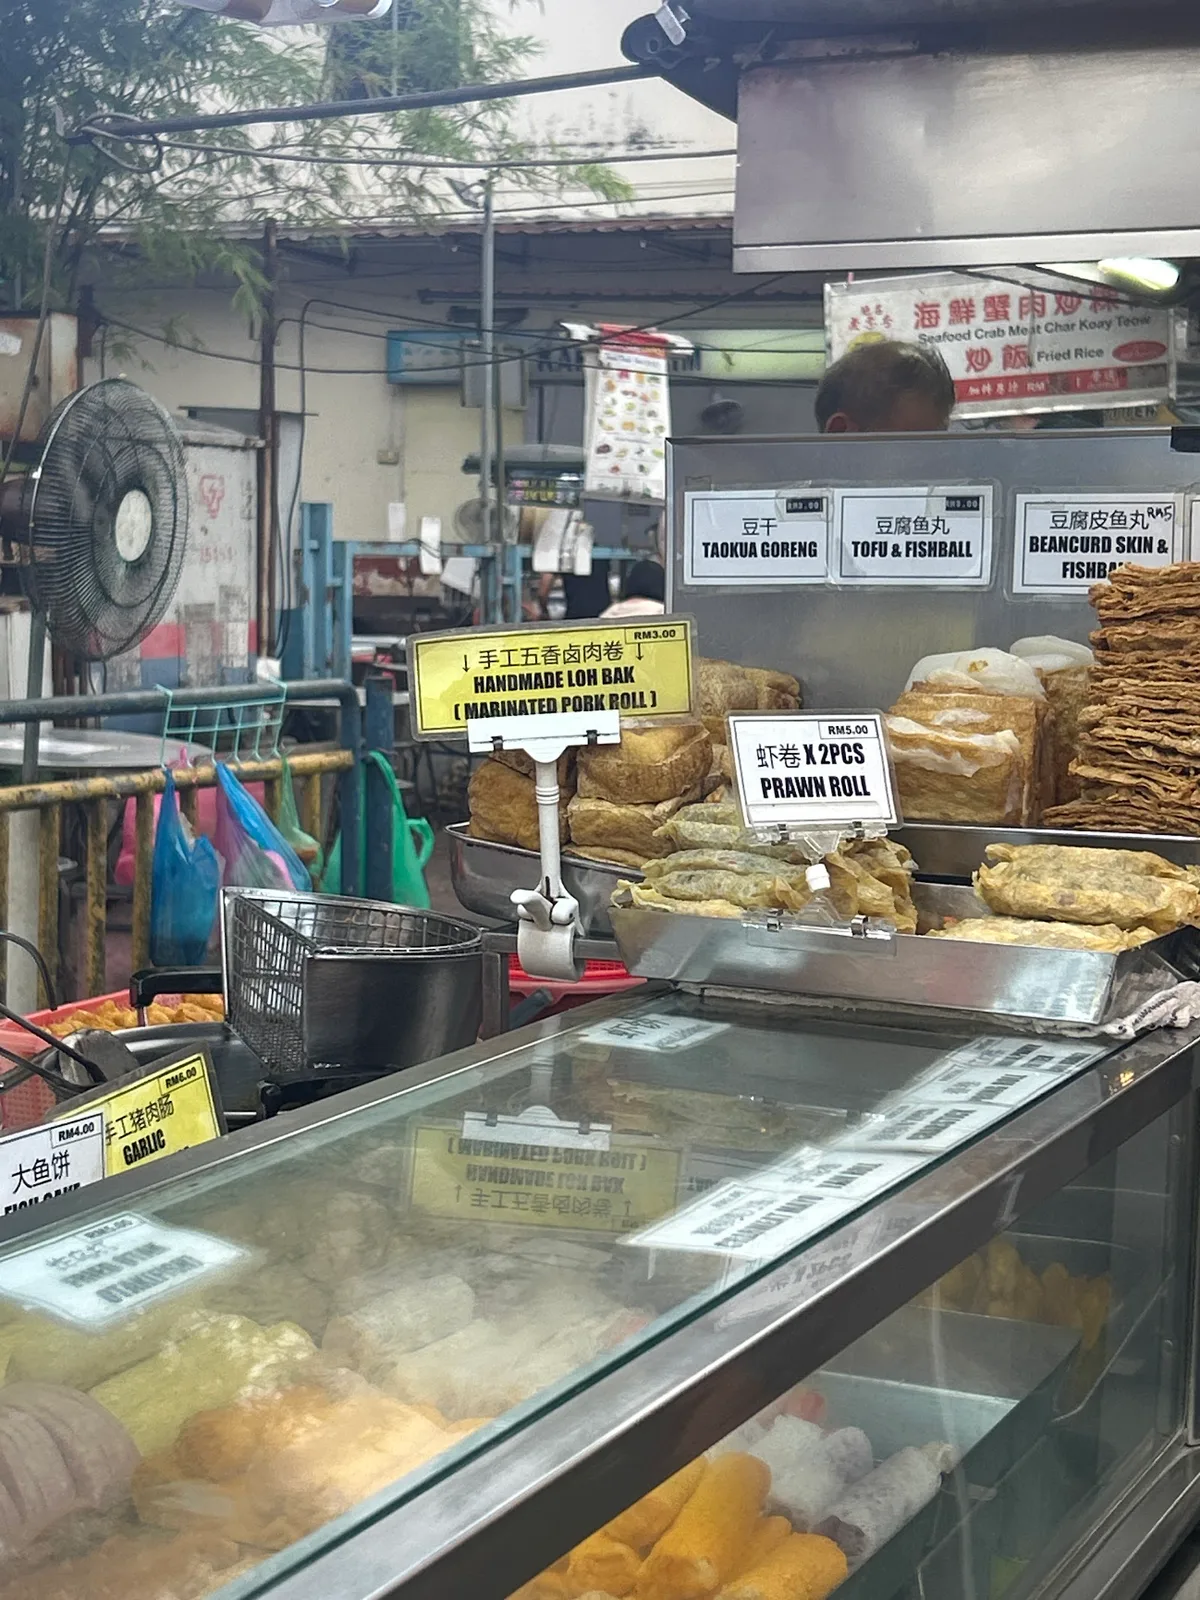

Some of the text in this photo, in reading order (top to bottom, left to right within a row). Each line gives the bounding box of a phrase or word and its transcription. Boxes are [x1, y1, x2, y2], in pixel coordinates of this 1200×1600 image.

[918, 329, 971, 345] Seafood
[974, 326, 1006, 340] Crab
[1008, 323, 1041, 337] Meat
[1044, 320, 1076, 334] Char
[965, 343, 1029, 373] 炒飯
[1037, 349, 1071, 362] Fried
[1074, 347, 1104, 359] Rice
[742, 518, 778, 536] 豆干
[875, 515, 950, 535] 豆腐鱼丸
[1050, 510, 1149, 530] 豆腐皮鱼丸
[702, 541, 818, 558] TAOKUA GORENG
[852, 541, 972, 558] TOFU & FISHBALL
[1029, 536, 1169, 553] BEANCURD SKIN &
[1062, 561, 1131, 579] FISHBA
[634, 629, 676, 640] RM3.00
[478, 641, 623, 669] 手工五香卤肉卷
[474, 666, 635, 694] HANDMADE LOH BAK
[464, 698, 557, 720] MARINATED
[561, 694, 605, 712] PORK
[609, 692, 647, 710] ROLL
[828, 725, 868, 735] RM5.00
[757, 742, 865, 769] 虾卷 X 2PCS
[760, 775, 871, 799] PRAWN ROLL
[58, 1122, 95, 1142] RM4.00
[123, 1128, 166, 1166] GARLIC
[11, 1149, 70, 1194] 大鱼饼
